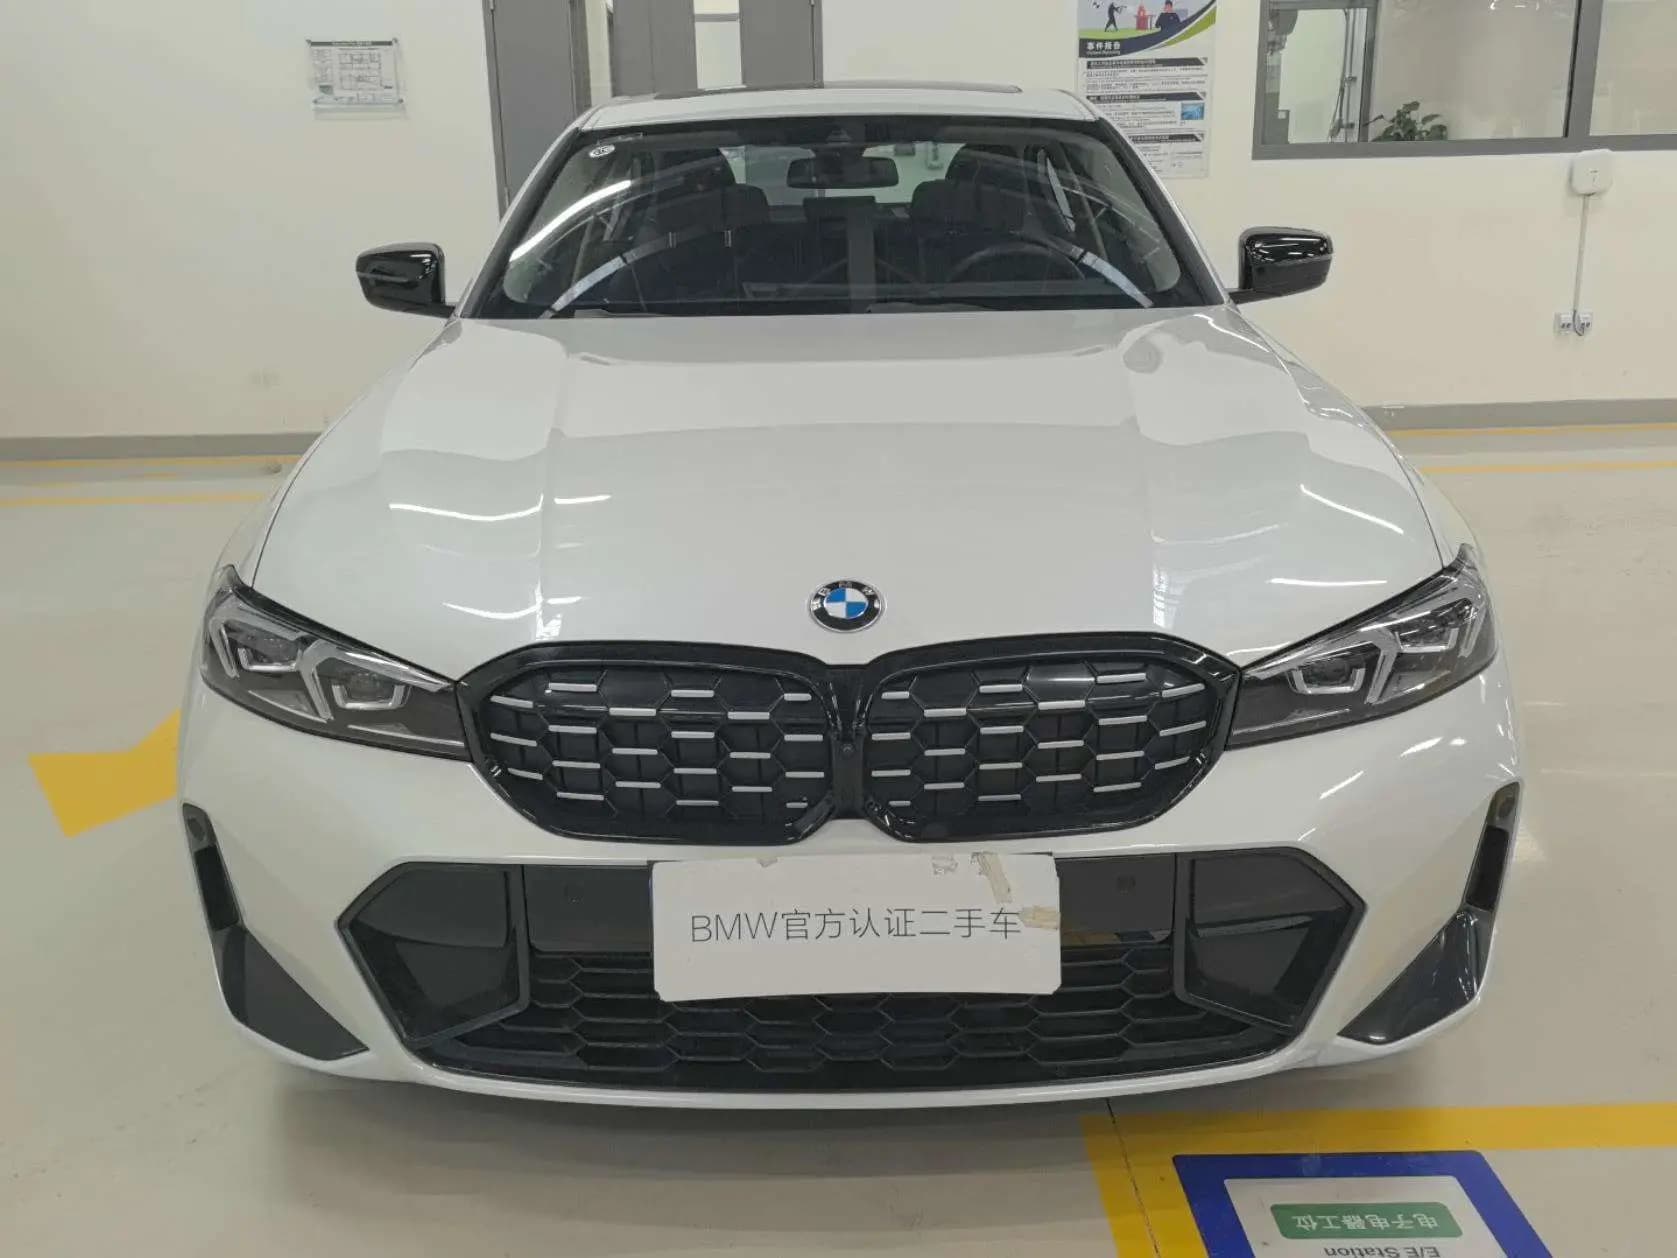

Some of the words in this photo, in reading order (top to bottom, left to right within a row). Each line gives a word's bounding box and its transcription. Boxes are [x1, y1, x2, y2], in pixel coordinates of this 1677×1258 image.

[690, 907, 1022, 943] BMW官方认证二手车
[1291, 1213, 1438, 1231] 电子电器工位
[1323, 1246, 1400, 1258] Station
[1403, 1246, 1441, 1258] E/E
